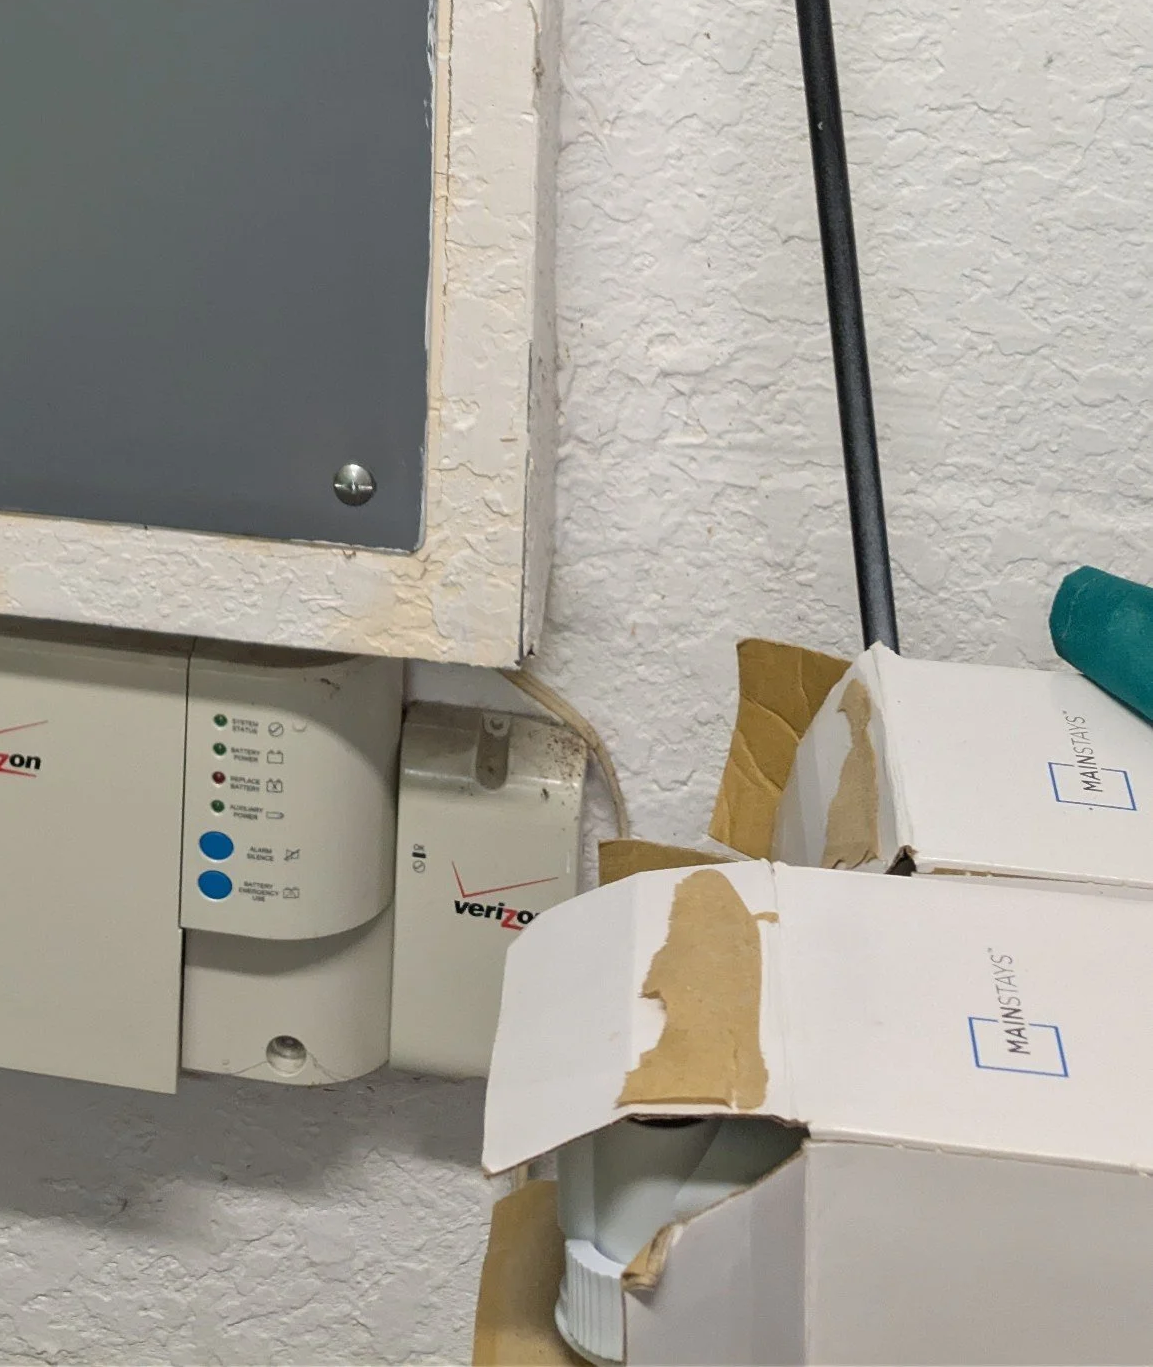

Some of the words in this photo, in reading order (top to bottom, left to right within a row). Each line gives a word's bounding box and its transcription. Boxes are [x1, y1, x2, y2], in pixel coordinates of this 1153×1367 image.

[232, 719, 259, 728] SYSTEM
[233, 726, 258, 735] STATUS
[231, 747, 260, 756] BATTERY
[1065, 715, 1103, 792] MAINSTAYS
[234, 755, 258, 763] POWER
[230, 776, 260, 785] REPLACE
[230, 783, 260, 793] BATTERY
[234, 812, 258, 820] POWER
[250, 846, 272, 854] ALARM
[247, 853, 274, 862] SILENCE
[244, 881, 273, 890] BATTERY
[990, 954, 1030, 1055] MAINSTAYS
